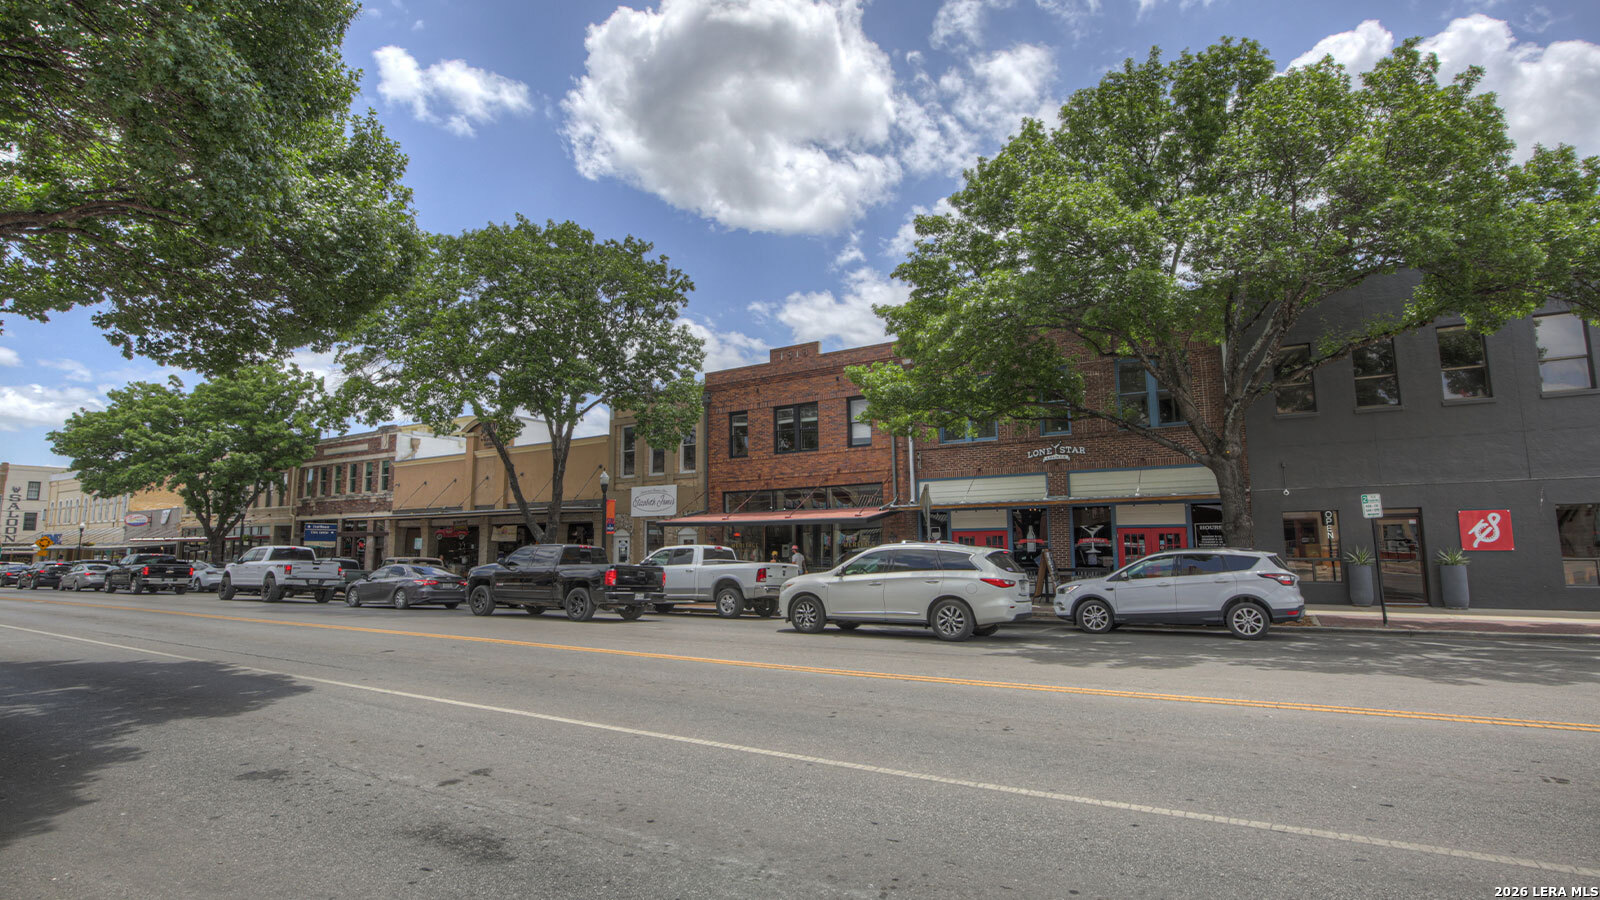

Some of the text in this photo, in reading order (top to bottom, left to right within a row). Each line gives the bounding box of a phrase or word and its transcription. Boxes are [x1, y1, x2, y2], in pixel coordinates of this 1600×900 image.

[1027, 447, 1053, 459] LONE
[1059, 445, 1086, 454] STAR
[4, 494, 22, 542] SALOON
[1324, 510, 1334, 539] OPEN
